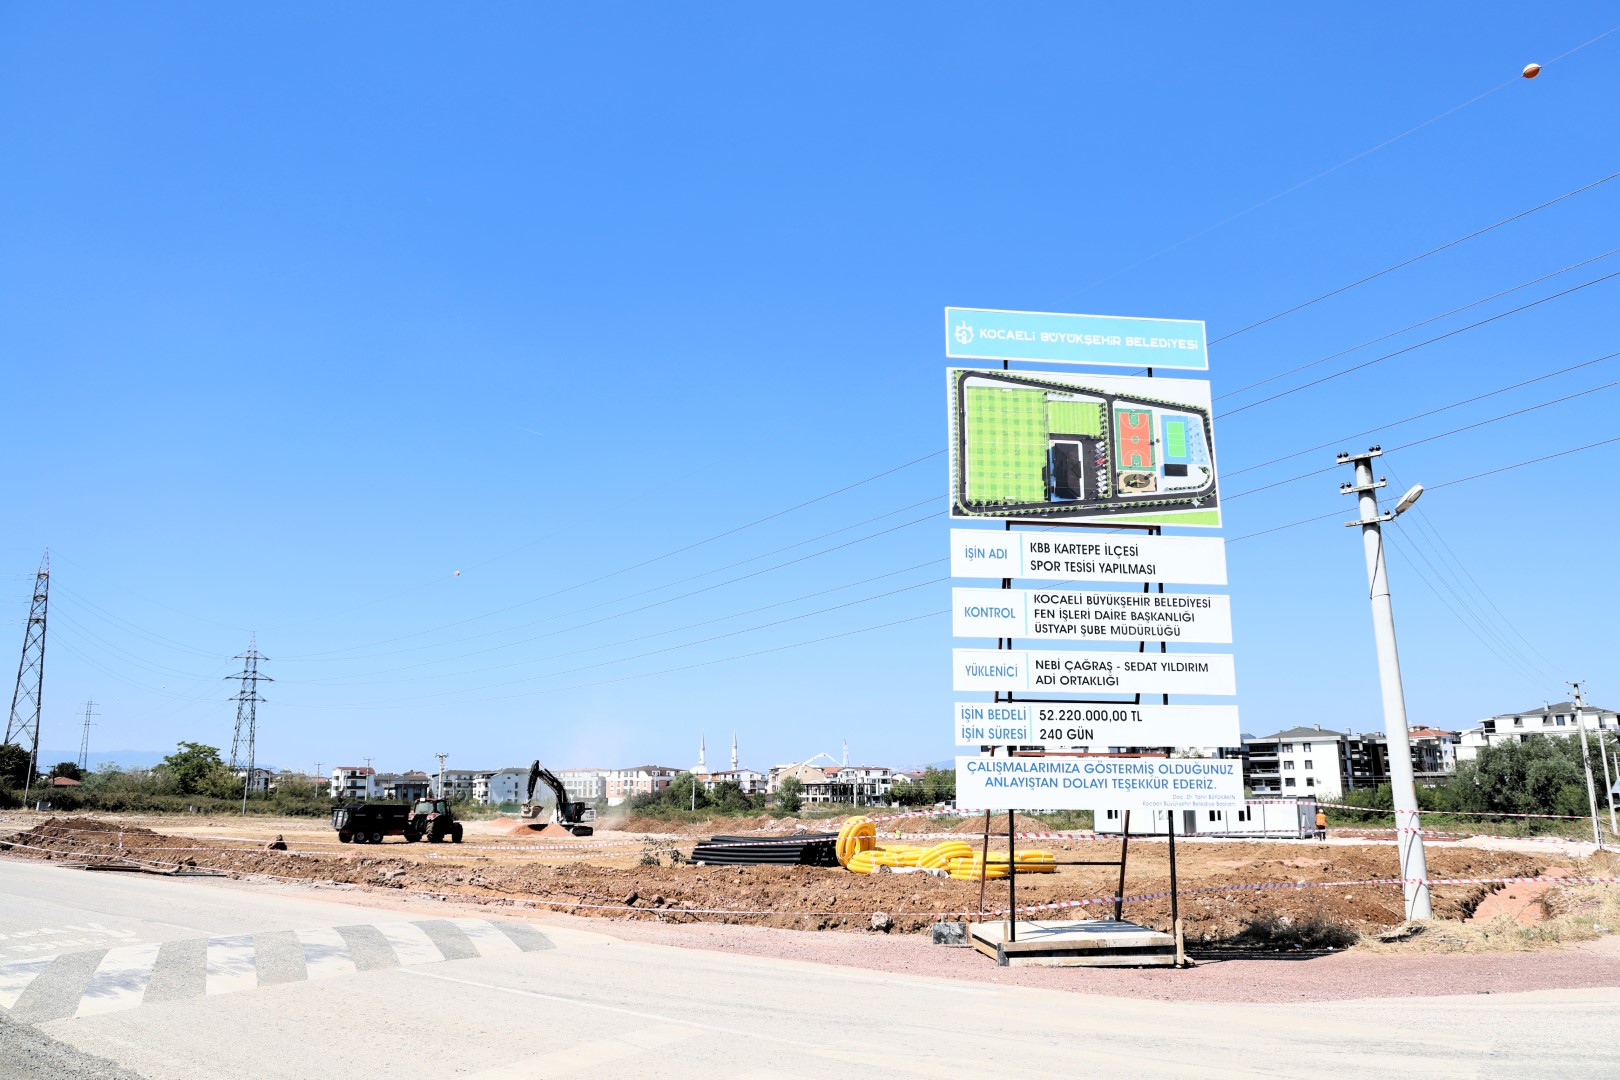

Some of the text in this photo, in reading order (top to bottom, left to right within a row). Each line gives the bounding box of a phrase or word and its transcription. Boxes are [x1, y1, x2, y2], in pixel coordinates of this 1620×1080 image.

[964, 544, 1008, 562] İŞİN ADI
[1029, 542, 1140, 559] KBB KARTEPE İLÇESİ
[1030, 558, 1157, 575] SPOR TESİSİ YAPILMASI
[1033, 593, 1212, 609] KOCAELİ BÜYÜKŞEHİR BELEDİYESİ
[963, 606, 1016, 619] KONTROL
[1033, 607, 1196, 624] FEN İŞLERİ DAİRE BAŞKANLIĞI
[1034, 621, 1181, 638] ÜSTYAPI ŞUBE MÜDÜRLÜĞÜ
[964, 662, 1018, 678] YÜKLENİCİ
[1035, 658, 1061, 670] NEBİ
[1064, 658, 1114, 676] ÇAĞRAŞ
[1124, 661, 1158, 672] SEDAT
[1161, 662, 1209, 673] YILDIRIM
[1035, 673, 1120, 686] ADİ ORTAKLIĞI
[961, 705, 1027, 723] İŞİN BEDELİ
[1039, 710, 1143, 723] 52.220.000,00 TL
[961, 725, 1027, 742] İŞİN SÜRESİ
[1039, 726, 1094, 740] 240 GÜN
[966, 761, 1234, 777] ÇALIŞMALARIMIZA GÖSTERMİŞ OLDUĞUNUZ
[985, 775, 1217, 792] ANLAYIŞTAN DOLAYI TEŞEKKÜR EDERİZ.
